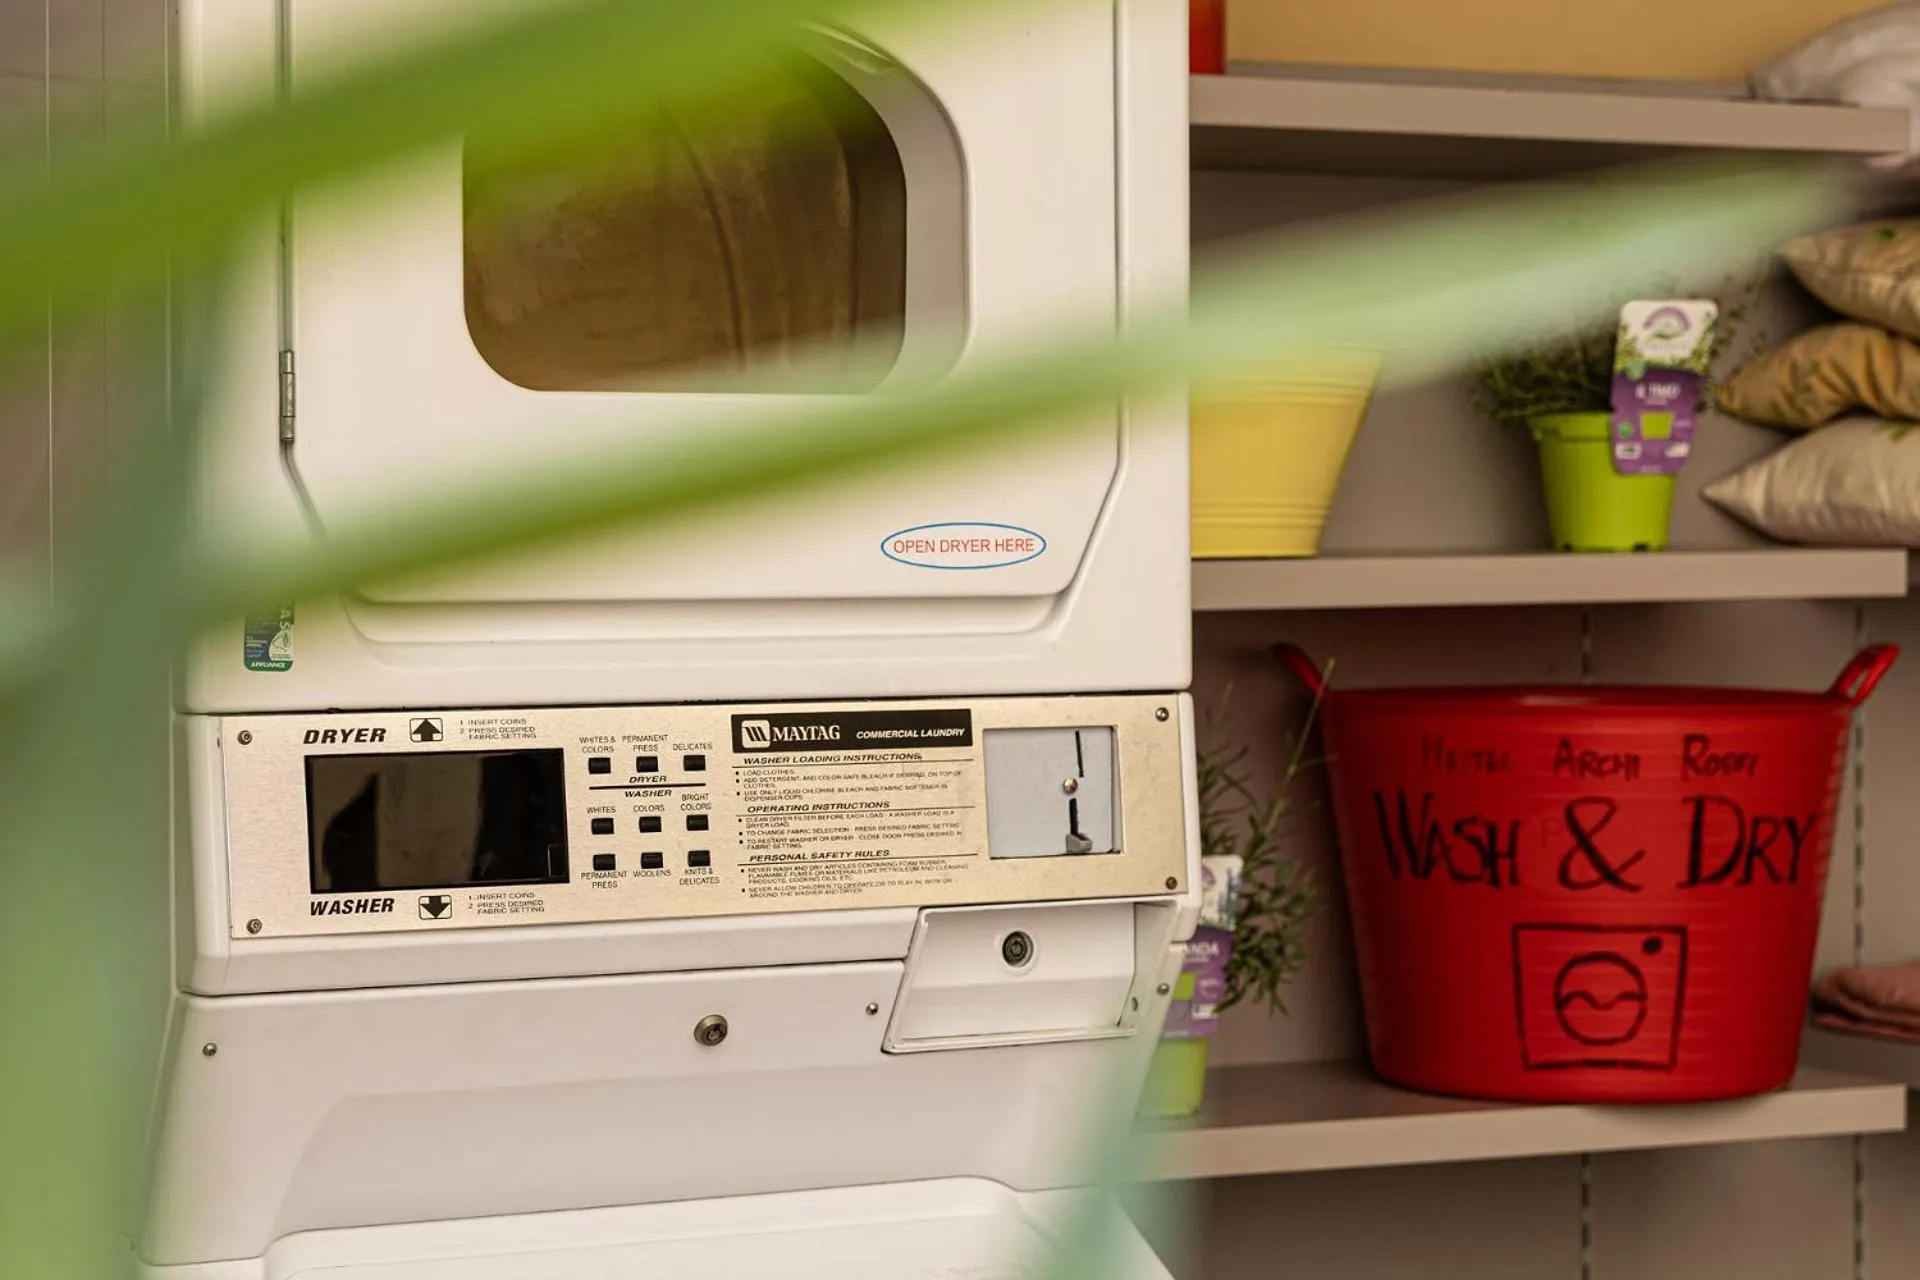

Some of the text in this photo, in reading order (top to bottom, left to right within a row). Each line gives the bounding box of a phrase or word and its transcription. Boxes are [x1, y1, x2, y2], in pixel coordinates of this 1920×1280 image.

[893, 538, 1034, 553] OPEN DRYER HERE
[303, 728, 387, 744] DRYER
[772, 725, 841, 742] MAYTAG
[856, 728, 965, 740] COMMERCIAL LAUNDRY
[579, 736, 609, 744] WHITES
[621, 734, 669, 743] PERMANENT
[581, 745, 615, 753] COLORS
[633, 744, 659, 752] PRESS
[672, 742, 713, 751] DELICATES
[743, 756, 790, 765] WASHER
[792, 755, 841, 763] LOADING
[629, 775, 667, 783] DRYER
[624, 789, 672, 798] WASHER
[681, 793, 709, 801] BRIGHT
[586, 806, 616, 814] WHITES
[633, 804, 665, 813] COLORS
[680, 803, 712, 811] COLORS
[747, 801, 890, 813] OPERATING INSTRUCTIONS
[1374, 788, 1819, 893] WASH & DRY
[749, 849, 890, 862] PERSONAL SAFETY RULES
[580, 870, 628, 880] PERMANENT
[633, 869, 672, 878] WOOLENS
[684, 867, 706, 875] KNITS
[592, 880, 618, 888] PRESS
[679, 877, 720, 886] DELICATES
[310, 898, 395, 916] WASHER
[508, 899, 544, 907] DESIRED
